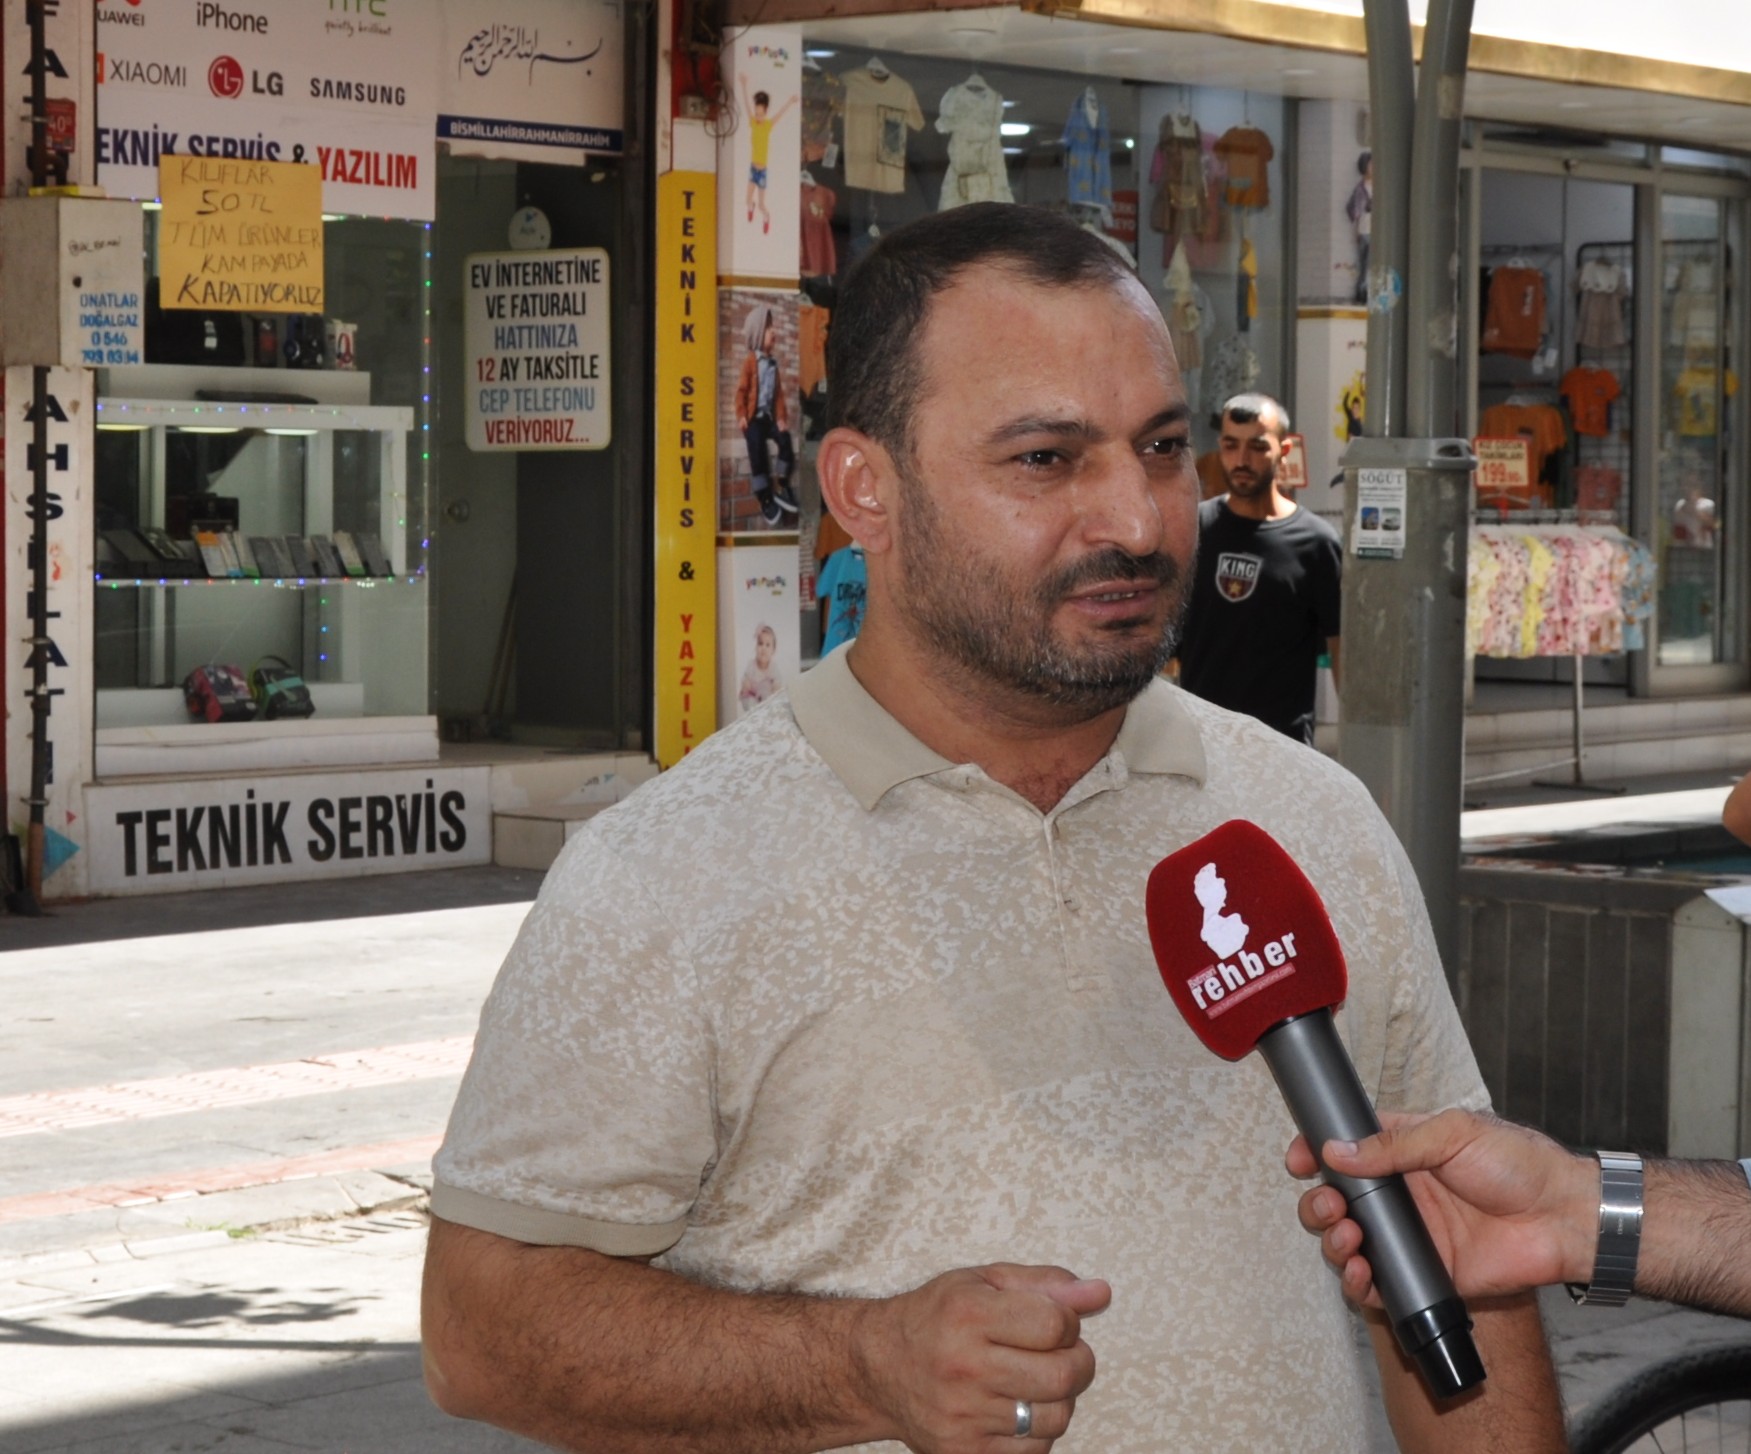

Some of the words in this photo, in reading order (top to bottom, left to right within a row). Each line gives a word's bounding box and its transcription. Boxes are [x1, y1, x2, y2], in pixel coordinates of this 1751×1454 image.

[97, 10, 145, 27] UAWEI
[197, 2, 268, 34] iPhone
[110, 59, 187, 87] XIAOMI
[252, 70, 284, 96] LG
[310, 77, 406, 106] SAMSUNG
[451, 121, 610, 147] BİSMİLLAHİRRAHMANİRRAHİM
[98, 124, 178, 167] EKNİK
[188, 132, 280, 162] SERVİS
[293, 144, 309, 164] &
[317, 146, 417, 189] YAZILIM
[181, 159, 274, 184] KILIFLAR
[196, 189, 240, 215] 50
[247, 193, 273, 213] TL
[169, 221, 226, 248] TÜM
[471, 264, 492, 289] EV
[496, 255, 601, 288] İNTERNETİNE
[680, 190, 695, 343] TEKNİK
[177, 273, 322, 305] KAPATIYORUZ
[80, 311, 138, 327] DOĞALGAZ
[485, 294, 506, 319] VE
[511, 292, 586, 318] FATURALI
[91, 331, 101, 346] 0
[495, 324, 578, 351] HATTINIZA
[477, 358, 495, 382] 12
[499, 357, 520, 381] AY
[524, 351, 599, 381] TAKSİTLE
[479, 388, 509, 413] CEP
[514, 387, 595, 413] TELEFONU
[485, 415, 589, 444] VERİYORUZ...
[680, 376, 694, 527] SERVİS
[678, 561, 695, 580] &
[1221, 559, 1256, 578] KING
[116, 789, 292, 877] TEKNİK
[307, 779, 467, 862] SERVİS
[1190, 931, 1298, 1010] rehber
